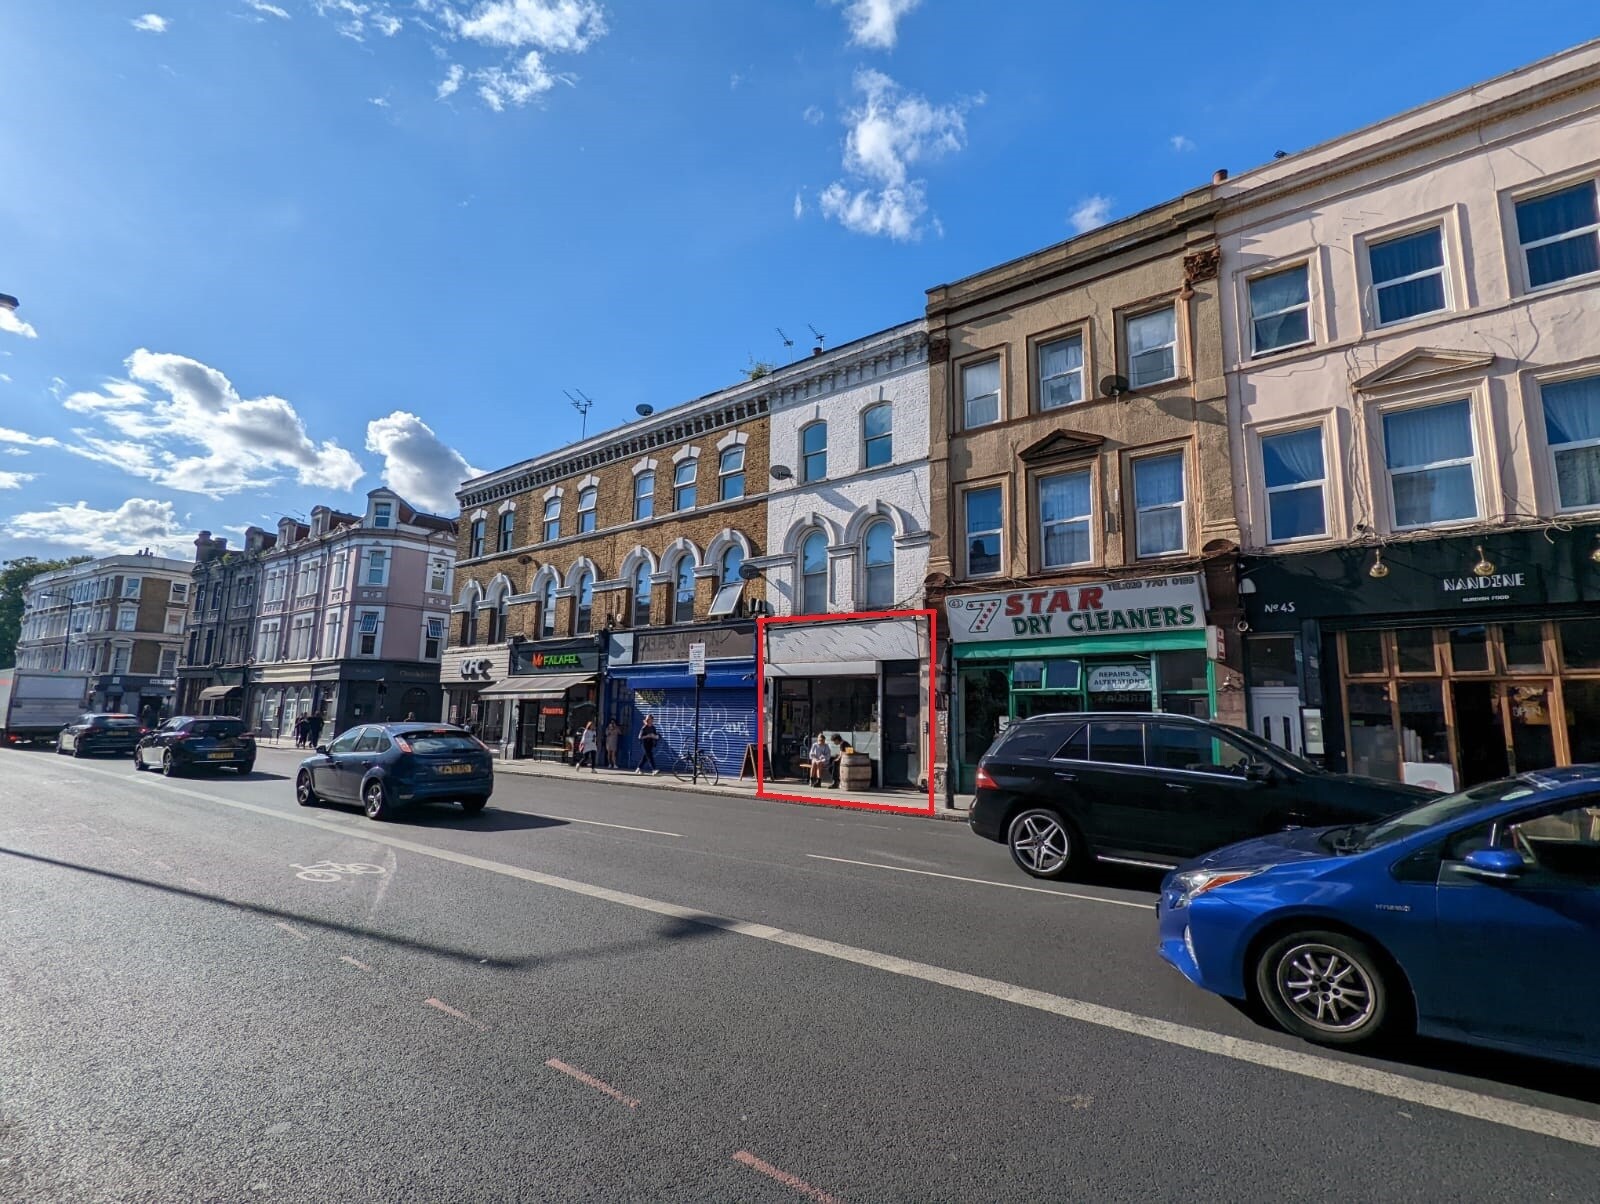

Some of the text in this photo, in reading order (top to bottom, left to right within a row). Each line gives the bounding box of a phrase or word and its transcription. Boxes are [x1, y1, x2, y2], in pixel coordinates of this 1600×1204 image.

[1443, 572, 1526, 592] NANDINE
[966, 587, 1104, 633] 7 STAR
[1012, 604, 1197, 637] DRY CLEANERS
[460, 659, 485, 675] KFC
[543, 654, 579, 666] FALAFEL
[1094, 678, 1146, 686] ALTERATIONS
[1098, 671, 1131, 679] REPAIRS
